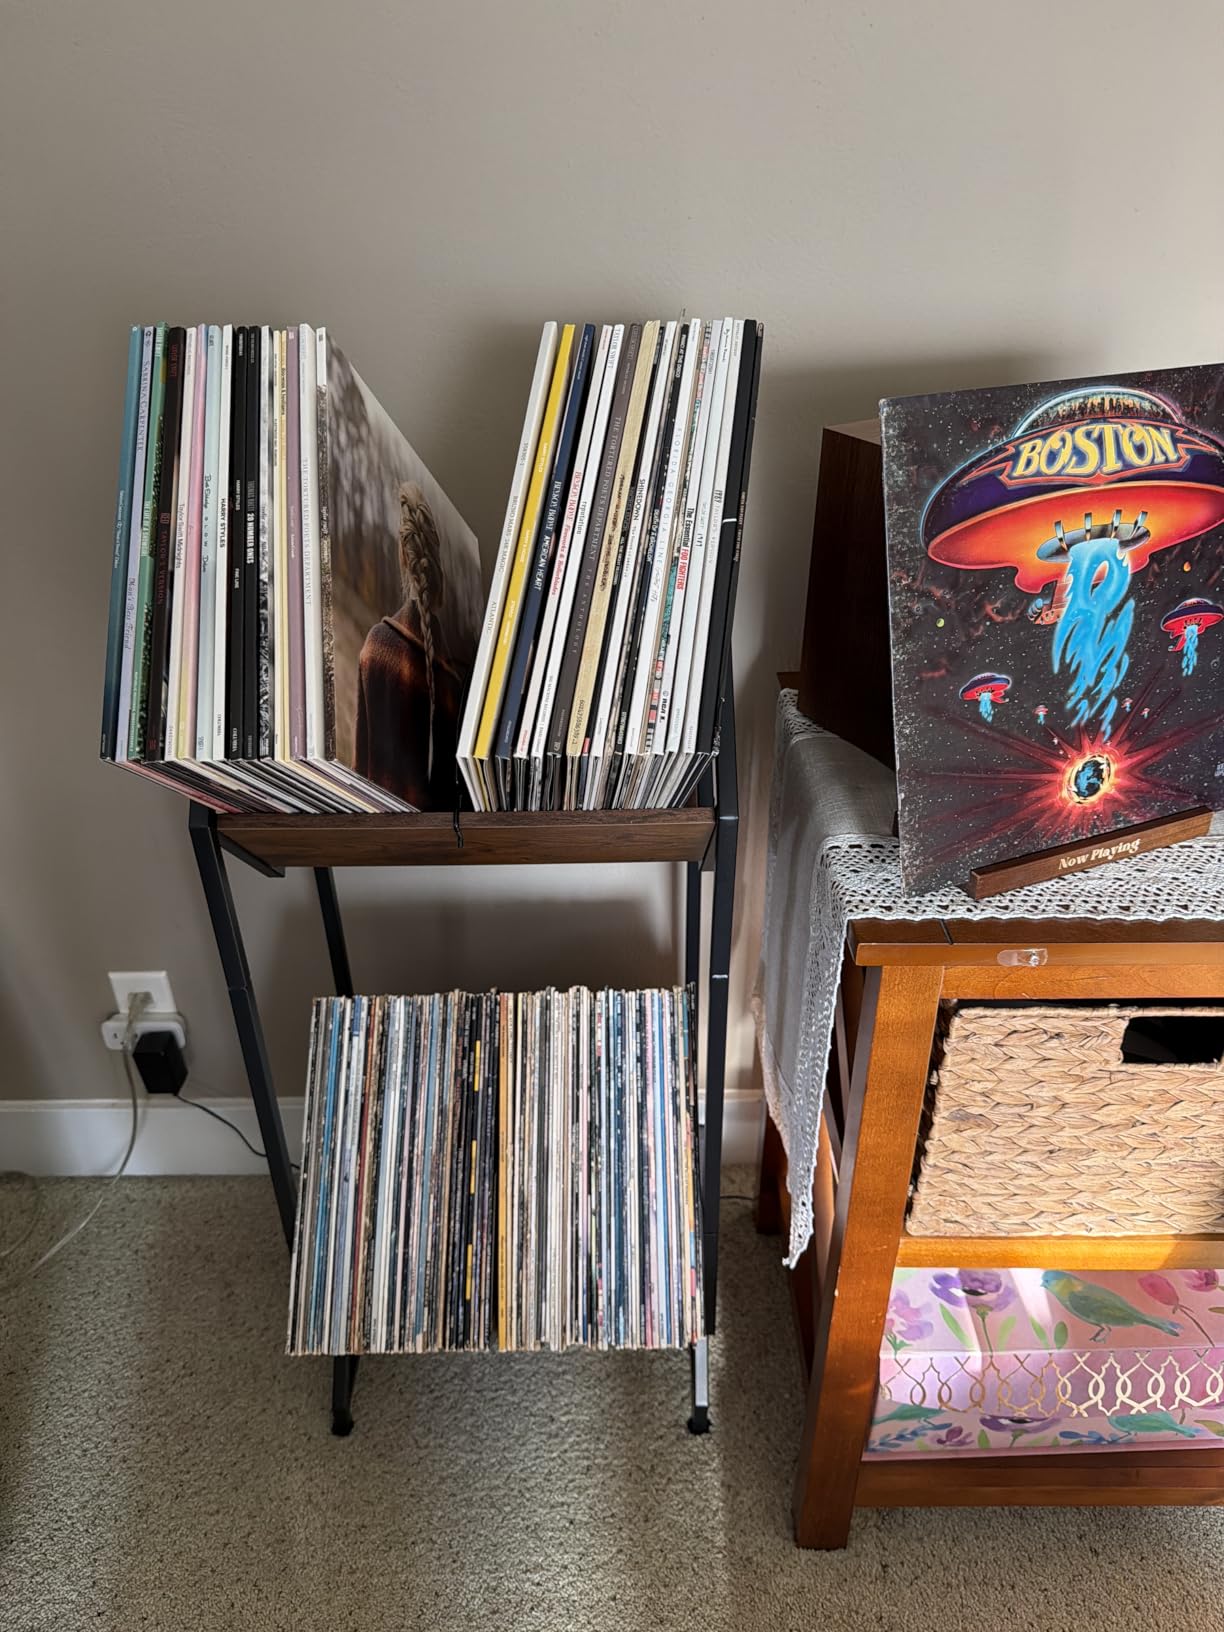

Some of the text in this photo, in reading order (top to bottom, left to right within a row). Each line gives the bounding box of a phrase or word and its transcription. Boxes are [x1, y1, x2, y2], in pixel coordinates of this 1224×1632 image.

[612, 416, 621, 432] THE
[604, 434, 617, 477] TORTURED
[1012, 423, 1178, 477] BOSTON
[509, 495, 518, 517] BRUNO
[598, 479, 609, 504] POETS
[632, 478, 645, 520] SHINEDOWN
[713, 489, 722, 503] 1989
[505, 518, 513, 536] MARS
[575, 501, 588, 534] reputation
[246, 522, 254, 546] NUMBER
[588, 506, 605, 560] DEPARTMENT
[175, 538, 183, 568] Midnights
[245, 548, 253, 563] ONES
[498, 550, 507, 572] MAGIC
[537, 535, 550, 567] AMERICAN
[675, 507, 694, 590] The Essential FOO FIGHTERS
[303, 551, 311, 605] DEPARTMENT
[533, 568, 544, 590] HEART
[550, 560, 563, 595] Rollerblades
[123, 623, 133, 649] Friend
[1058, 838, 1141, 869] Now Playing
